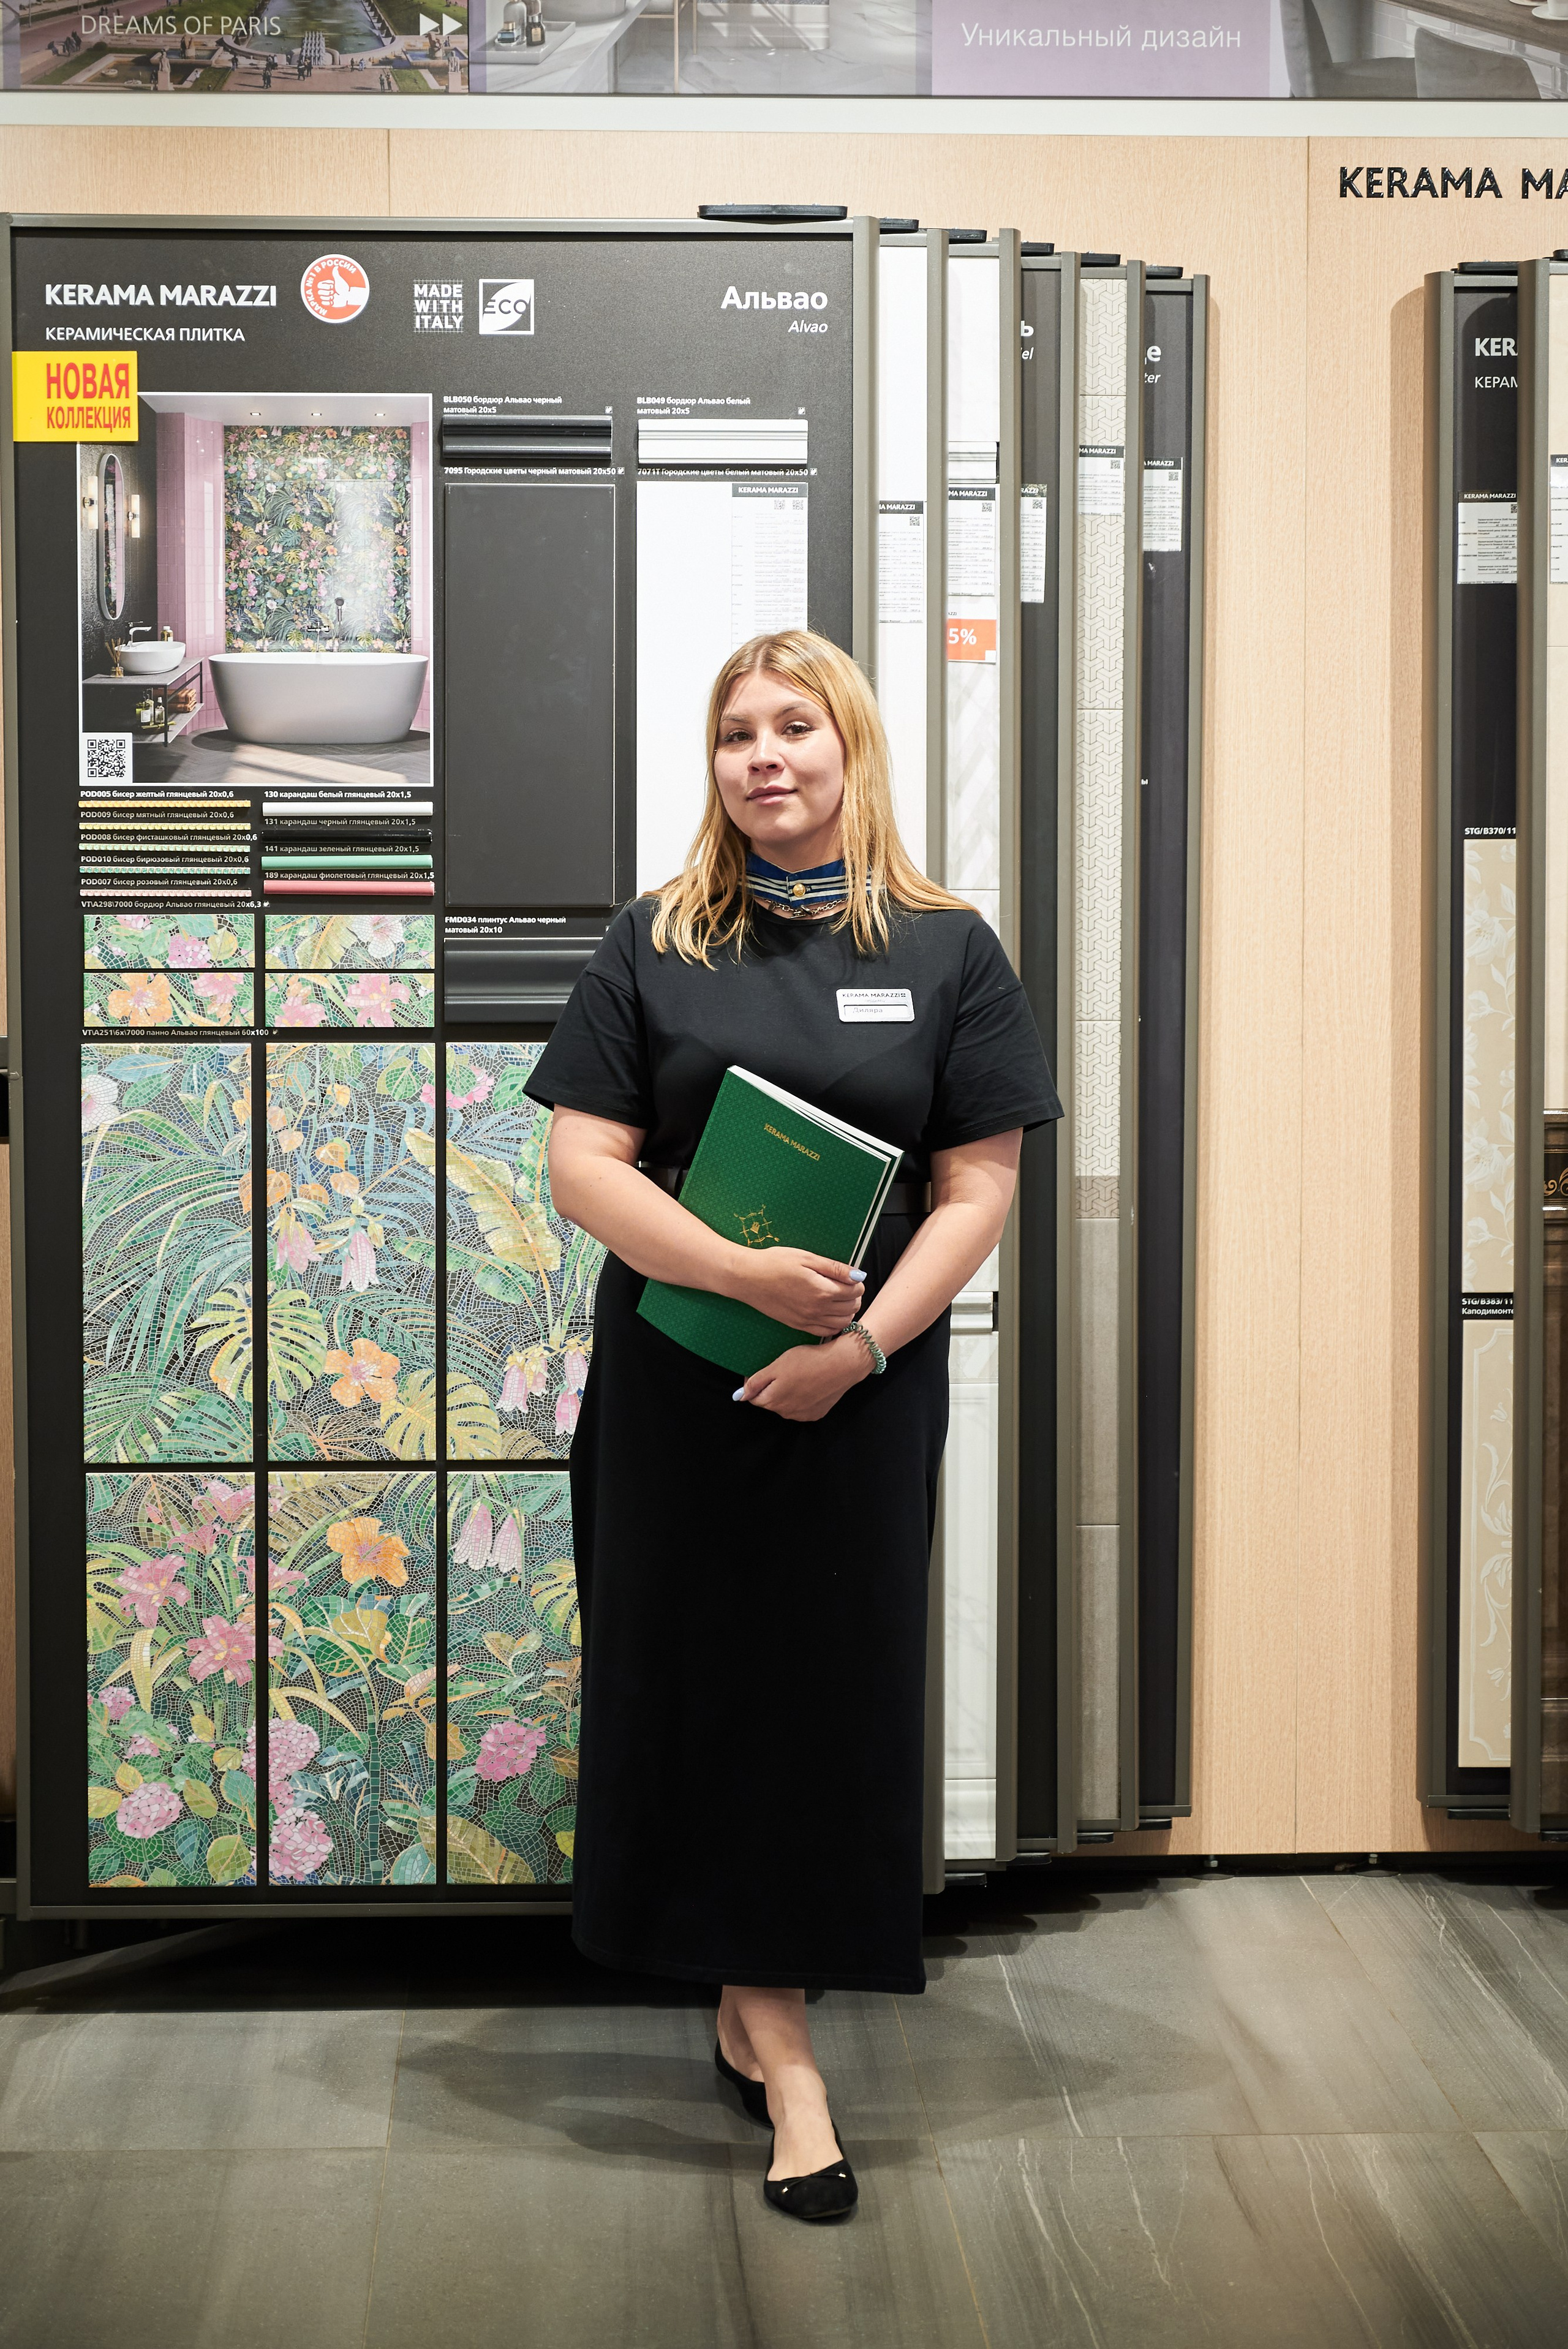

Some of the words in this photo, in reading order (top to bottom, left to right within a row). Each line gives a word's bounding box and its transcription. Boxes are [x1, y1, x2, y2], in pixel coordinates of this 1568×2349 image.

[81, 15, 177, 35] DREAMS
[184, 16, 213, 35] OF
[221, 17, 281, 36] PARIS
[962, 23, 1130, 47] Уникальный
[1142, 26, 1240, 51] дизайн
[1340, 167, 1502, 198] KERAMA
[306, 289, 328, 315] МАРКА
[321, 259, 356, 273] РОССИИ
[414, 284, 462, 297] MADE
[46, 284, 154, 305] KERAMA
[160, 285, 276, 306] MARAZZI
[721, 286, 827, 309] Альвао
[415, 300, 462, 313] WITH
[483, 299, 527, 314] ECO
[415, 315, 464, 328] ITALY
[787, 319, 828, 333] Alvao
[47, 328, 175, 341] КЕРАМИЧЕСКАЯ
[180, 328, 245, 341] ПЛИТКА
[1475, 337, 1518, 356] KER
[47, 363, 129, 399] НОВАЯ
[473, 395, 503, 405] бордюр
[532, 395, 562, 405] черный
[666, 396, 697, 406] бордюр
[725, 396, 751, 405] белый
[47, 406, 130, 432] КОЛЛЕКЦИЯ
[464, 467, 503, 476] Городские
[527, 467, 557, 477] черный
[558, 467, 592, 476] матовый
[661, 468, 700, 477] Городские
[750, 468, 785, 477] матовый
[111, 790, 135, 799] бисер
[166, 790, 208, 799] глянцевый
[208, 790, 234, 799] 20x0,6
[344, 790, 385, 799] глянцевый
[112, 811, 135, 820] бисер
[318, 818, 348, 827] черный
[112, 833, 135, 842] бисер
[136, 833, 189, 842] фисташковый
[190, 833, 231, 842] глянцевый
[232, 833, 258, 842] 20x0,6
[113, 855, 135, 864] бисер
[136, 855, 180, 864] бирюзовый
[181, 855, 222, 864] глянцевый
[113, 878, 135, 887] бисер
[136, 878, 169, 887] розовый
[170, 878, 211, 886] глянцевый
[318, 872, 366, 880] фиолетовый
[134, 900, 164, 909] бордюр
[537, 916, 567, 925] черный
[764, 1123, 790, 1144] KERAMA
[790, 1139, 820, 1161] MARAZZI
